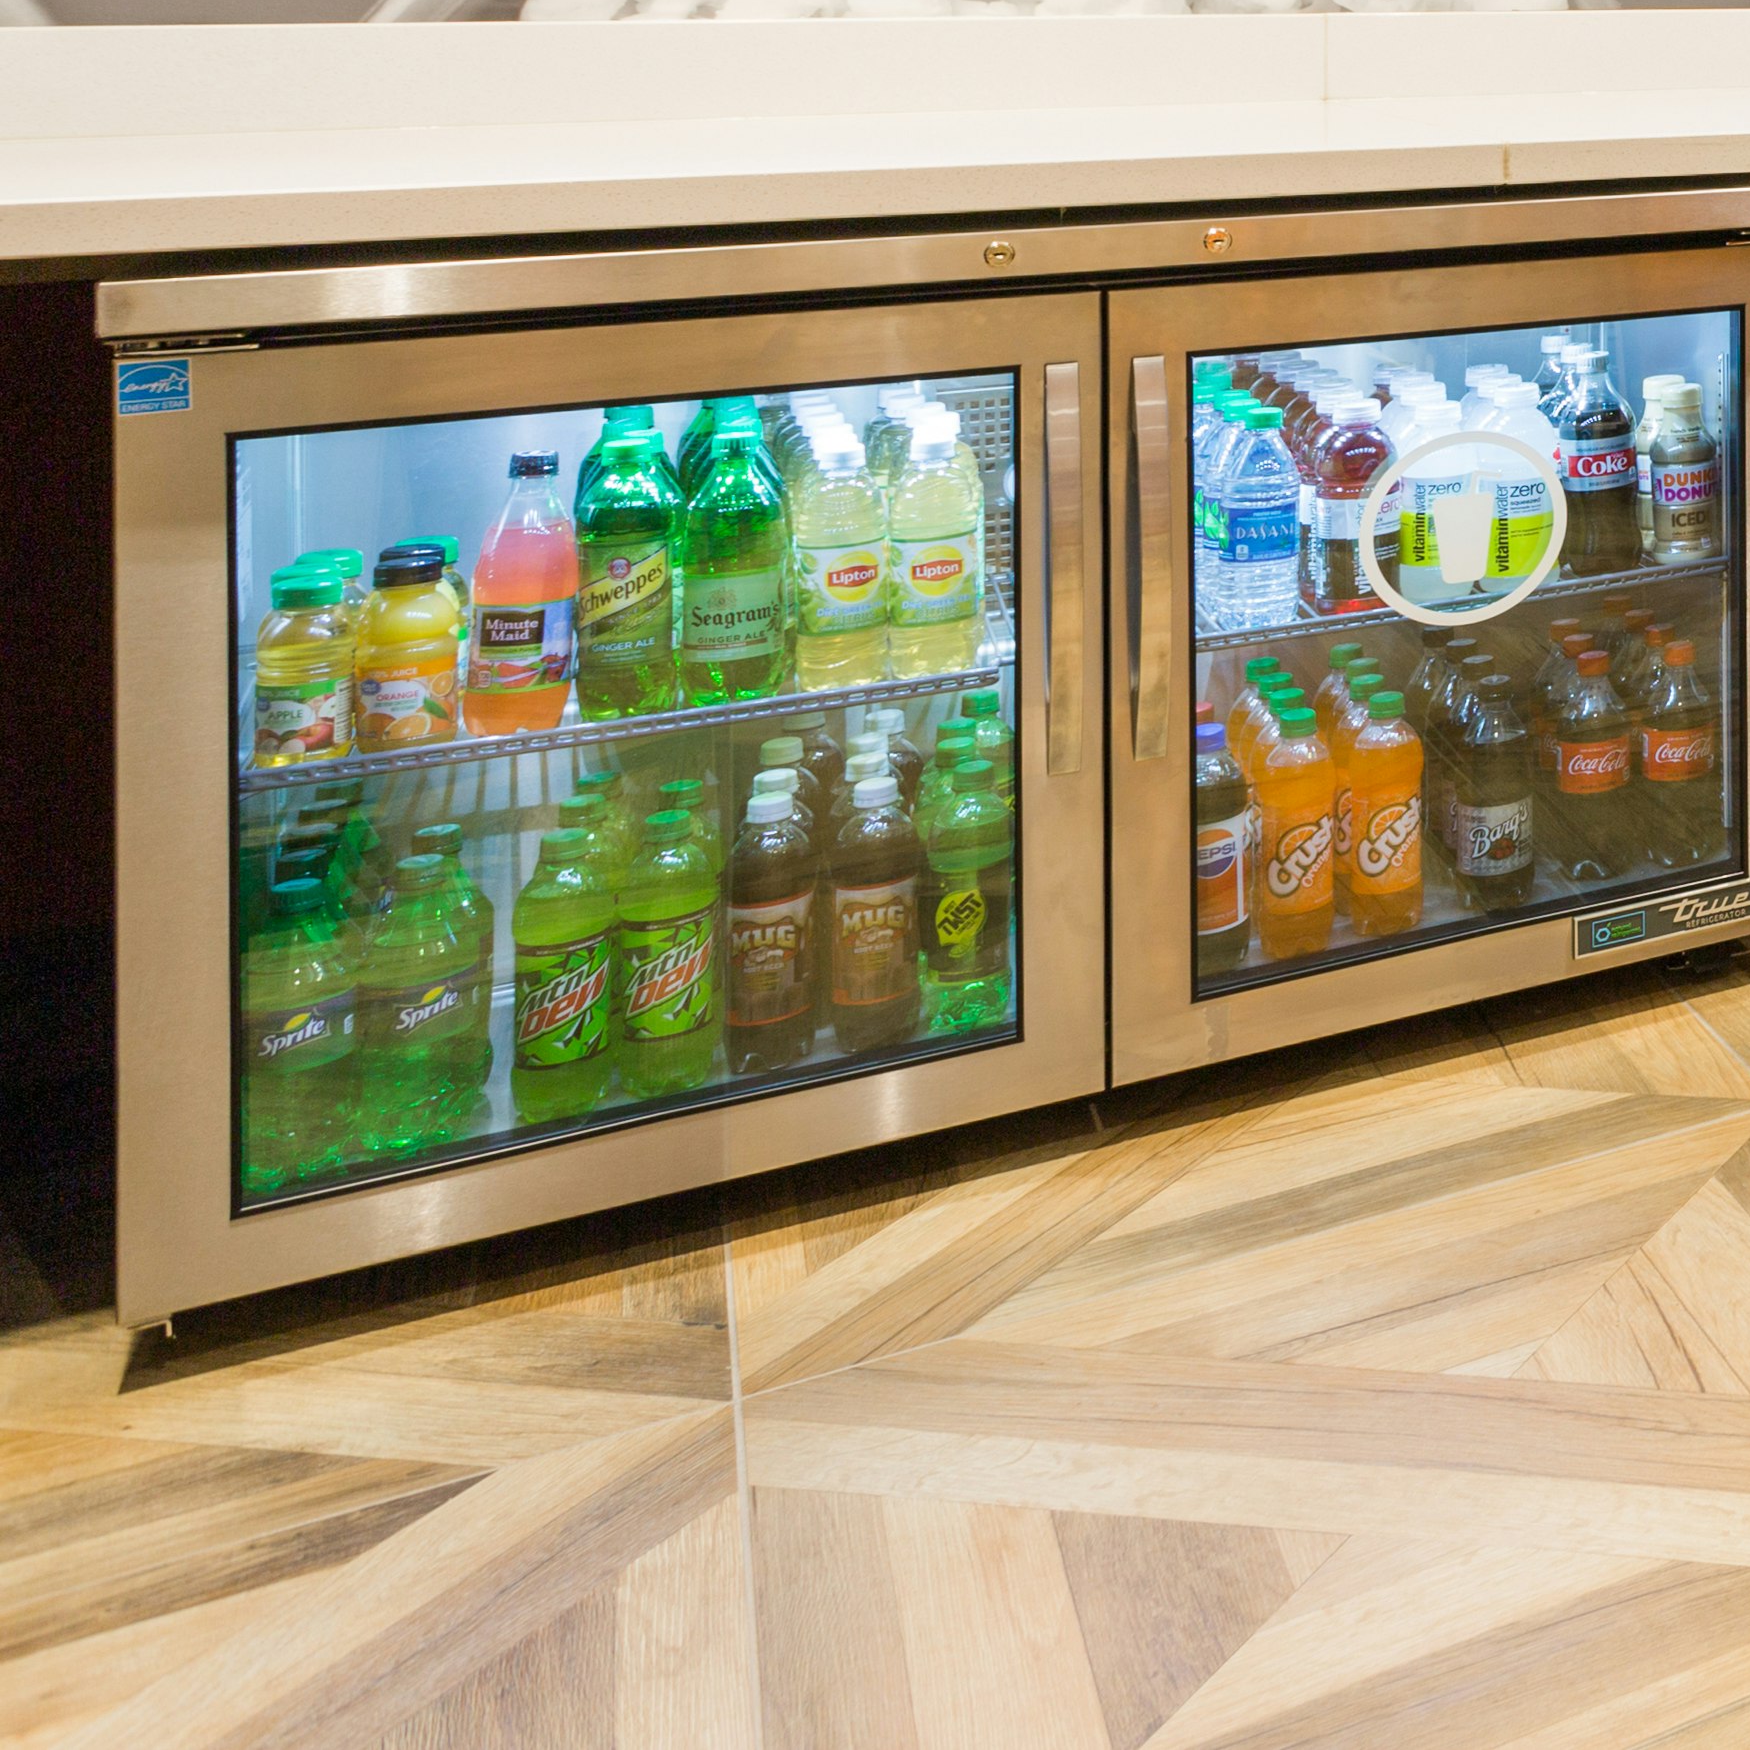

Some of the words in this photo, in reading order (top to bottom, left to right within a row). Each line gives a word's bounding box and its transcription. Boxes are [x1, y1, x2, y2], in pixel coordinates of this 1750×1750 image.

[121, 401, 161, 414] ENERGY
[161, 399, 187, 411] STAR
[1576, 454, 1630, 479] Coke
[1427, 480, 1463, 497] zero
[1510, 481, 1547, 499] zero
[1413, 481, 1428, 565] vitaminwater
[1496, 482, 1512, 573] vitaminwater
[1671, 509, 1708, 530] ICED
[1234, 522, 1295, 543] DASANI
[830, 566, 877, 588] Lipton
[914, 560, 961, 581] Lipton
[578, 561, 665, 621] Schweppes
[484, 616, 540, 632] Minute
[690, 601, 781, 630] Seagram's
[490, 628, 531, 642] Maid
[592, 639, 633, 653] GINGER
[634, 635, 656, 649] ALE
[697, 633, 742, 645] GINGER
[743, 630, 767, 642] ALE
[390, 666, 419, 678] JUICE
[375, 688, 420, 702] ORANGE
[268, 708, 304, 720] APPLE
[1357, 793, 1423, 877] Crush
[1469, 806, 1530, 861] Barq's
[1198, 840, 1238, 862] EPSI
[1267, 815, 1336, 897] Crush
[842, 904, 905, 929] MUG
[1686, 908, 1748, 929] REFRIGERATOR
[732, 925, 797, 951] MUG
[396, 985, 460, 1033] Sprite
[258, 1014, 327, 1059] Sprite
